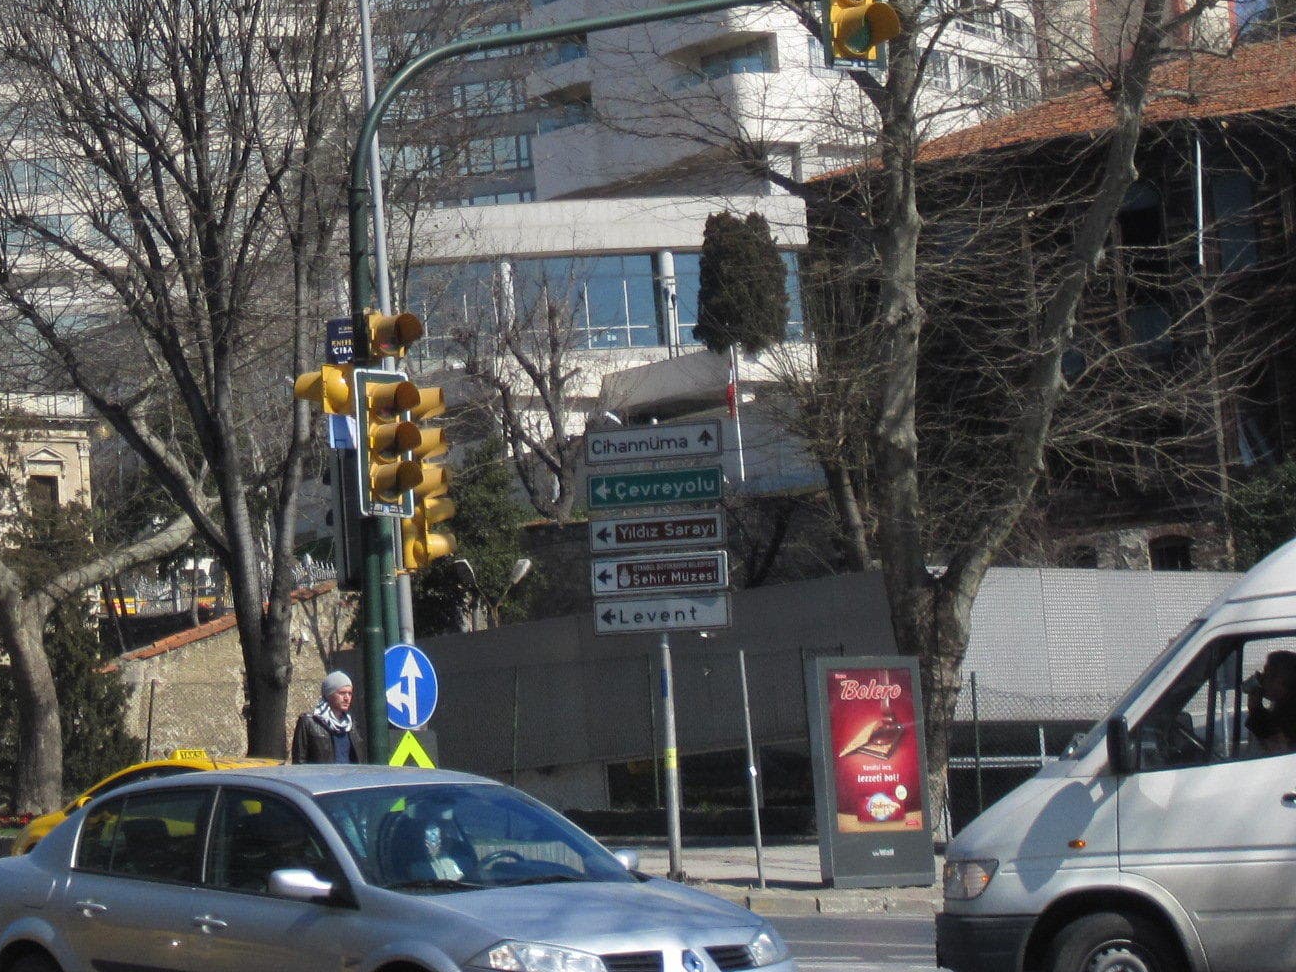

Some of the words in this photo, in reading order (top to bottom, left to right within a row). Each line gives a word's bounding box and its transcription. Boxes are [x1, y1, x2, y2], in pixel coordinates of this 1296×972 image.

[591, 435, 689, 455] Cihannüma
[615, 477, 715, 500] Çevreyolu
[671, 570, 718, 583] Müzesi
[619, 605, 698, 625] Levent
[840, 678, 902, 701] Bolero
